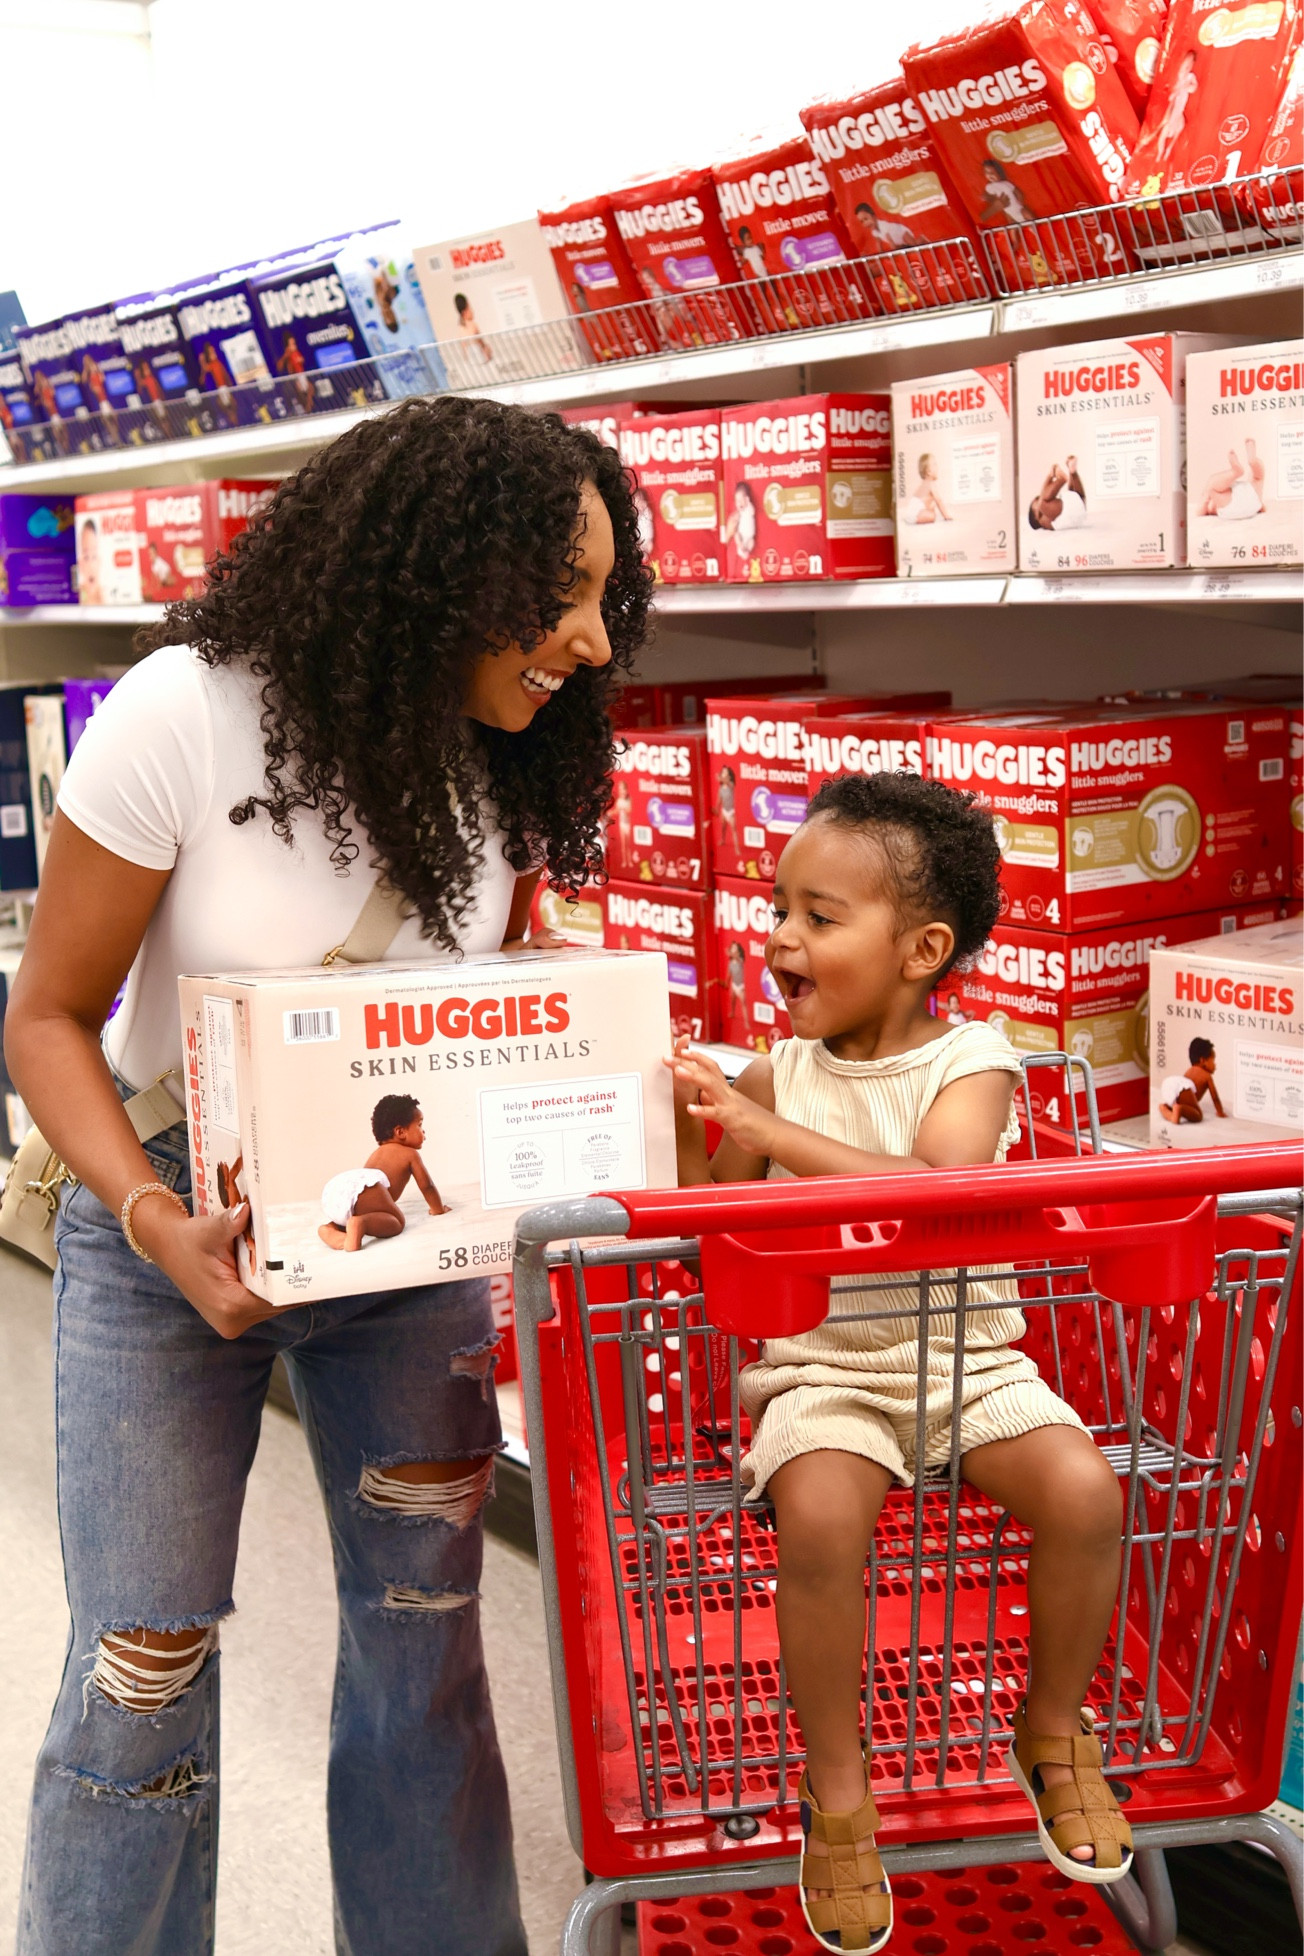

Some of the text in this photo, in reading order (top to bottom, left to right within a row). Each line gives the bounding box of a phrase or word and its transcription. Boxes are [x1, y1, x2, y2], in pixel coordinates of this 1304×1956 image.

[918, 58, 1047, 123] HUGGIES
[960, 100, 1050, 133] little snugglers
[808, 98, 926, 164] HUGGIES
[839, 161, 871, 183] little
[1222, 150, 1242, 184] 1
[716, 158, 830, 220] HUGGIES
[614, 196, 704, 240] HUGGIES
[763, 217, 793, 236] little
[541, 216, 607, 248] HUGGIES
[450, 240, 505, 270] HUGGIES
[1095, 233, 1124, 263] 2
[183, 293, 251, 335] HUGGIES
[259, 274, 348, 328] HUGGIES
[1044, 361, 1141, 399] HUGGIES
[1220, 363, 1304, 398] HUGGI
[911, 386, 986, 419] HUGGIES
[1037, 393, 1152, 417] SKIN ESSENTIALS
[1212, 401, 1247, 416] SKIN
[721, 412, 826, 460] HUGGIES
[907, 413, 994, 434] SKIN ESSENTIALS
[621, 424, 720, 466] HUGGIES
[641, 467, 715, 486] little snugglers
[744, 462, 769, 480] little
[769, 458, 821, 478] snugglers
[997, 530, 1007, 549] 2
[1158, 533, 1165, 552] 1
[1231, 545, 1267, 559] 76 84
[1057, 554, 1088, 568] 84 96
[706, 714, 804, 760] HUGGIE
[804, 733, 923, 777] HUGGIES
[933, 737, 1066, 788] HUGGIES
[1071, 736, 1172, 773] HUGGIES
[740, 762, 767, 780] little
[1072, 770, 1144, 790] little snugglers
[994, 793, 1059, 815] snugglers
[689, 858, 701, 881] 7
[608, 893, 694, 938] HUGGIES
[1046, 898, 1061, 925] 4
[641, 934, 696, 958] little movers
[1071, 935, 1167, 977] HUGGIES
[385, 986, 426, 994] Dermatologist
[511, 977, 552, 985] Dermatologues
[1072, 972, 1141, 993] little snugglers
[1175, 971, 1295, 1015] HUGGIES
[995, 993, 1059, 1015] snugglers
[1166, 1004, 1203, 1021] SKIN
[364, 992, 570, 1049] HUGGIES
[691, 1018, 703, 1040] 7
[350, 1040, 591, 1079] SKIN ESSENTIALS
[1255, 1053, 1283, 1064] protect
[195, 1010, 211, 1168] ESSENTIALS
[503, 1090, 617, 1111] Helps protect against
[187, 1026, 209, 1217] HUGGIES
[506, 1104, 613, 1125] top two causes of rash
[1046, 1097, 1060, 1123] 4
[587, 1134, 602, 1144] FREE
[510, 1160, 544, 1170] Leakproof
[515, 1151, 537, 1161] 100%
[438, 1247, 470, 1271] 58
